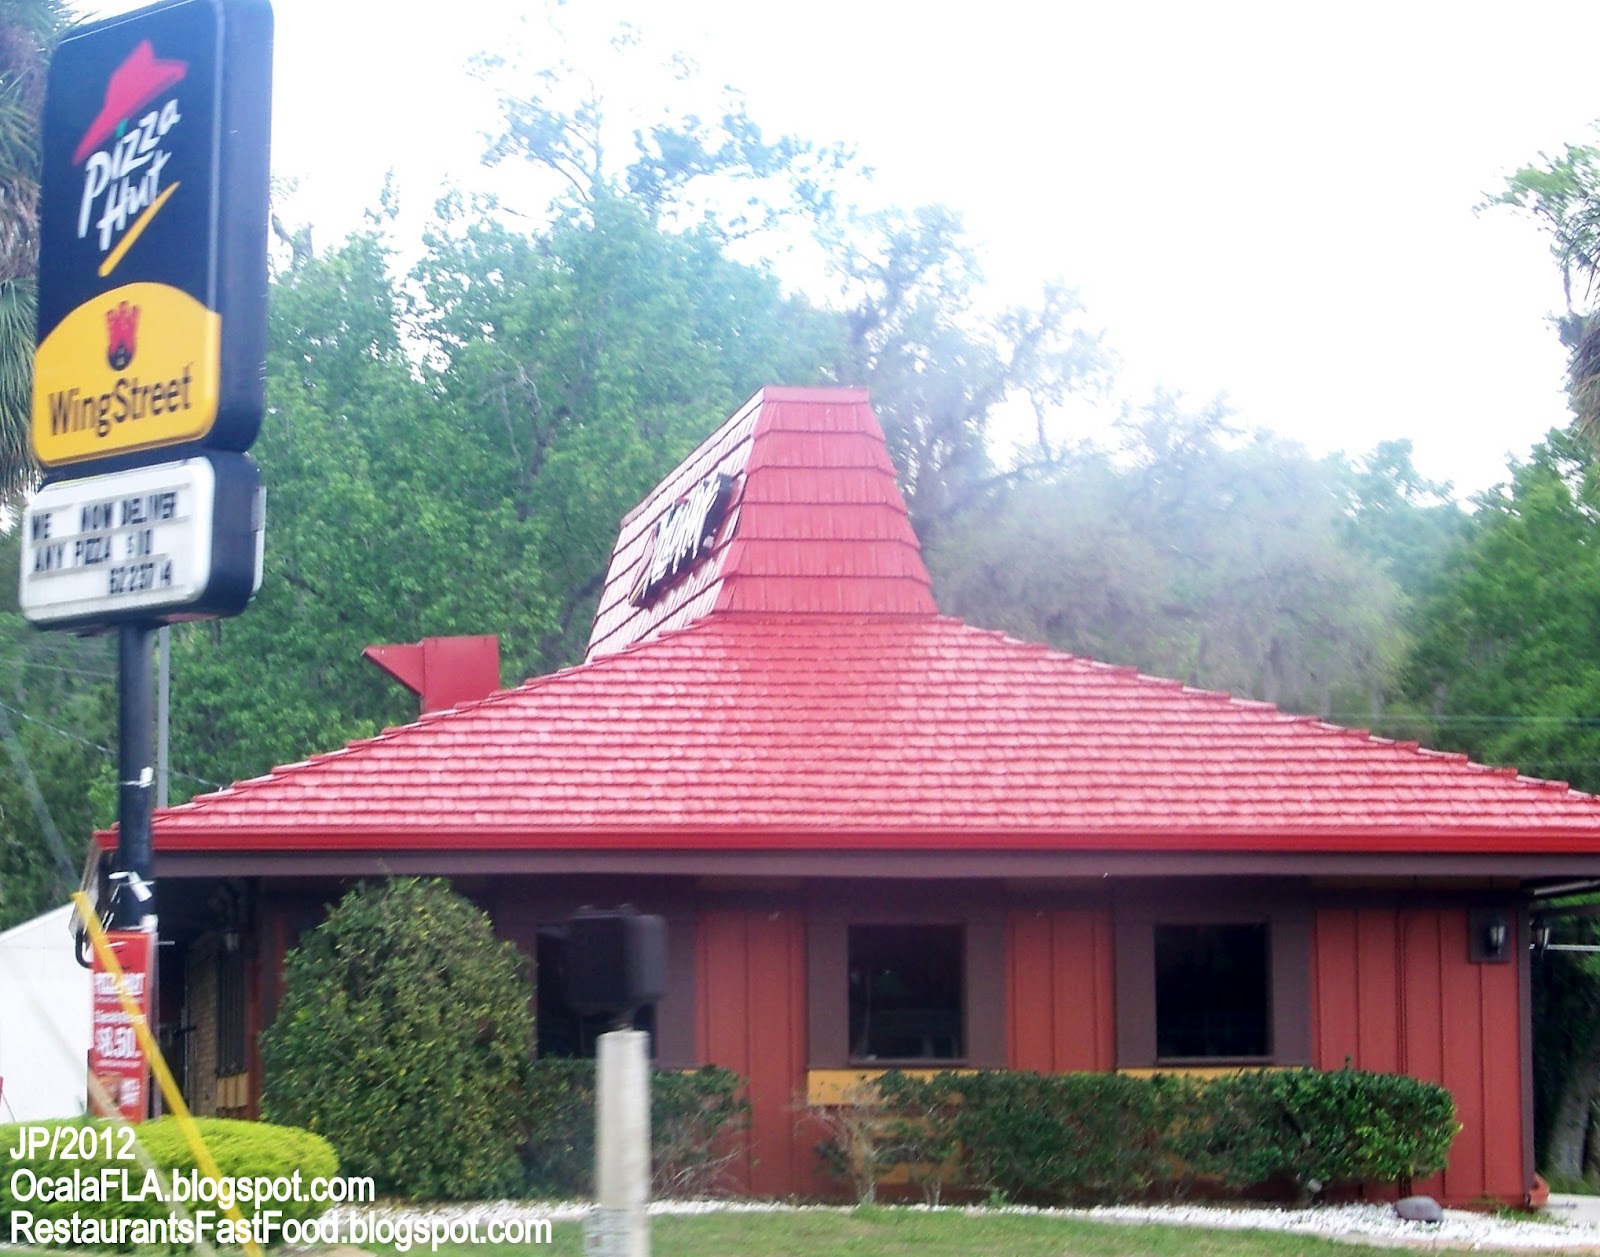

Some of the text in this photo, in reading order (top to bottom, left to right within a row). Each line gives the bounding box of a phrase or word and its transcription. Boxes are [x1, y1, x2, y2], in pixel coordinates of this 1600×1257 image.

[78, 99, 182, 238] Pizza
[96, 149, 172, 251] Hut
[47, 366, 194, 437] WingStreet
